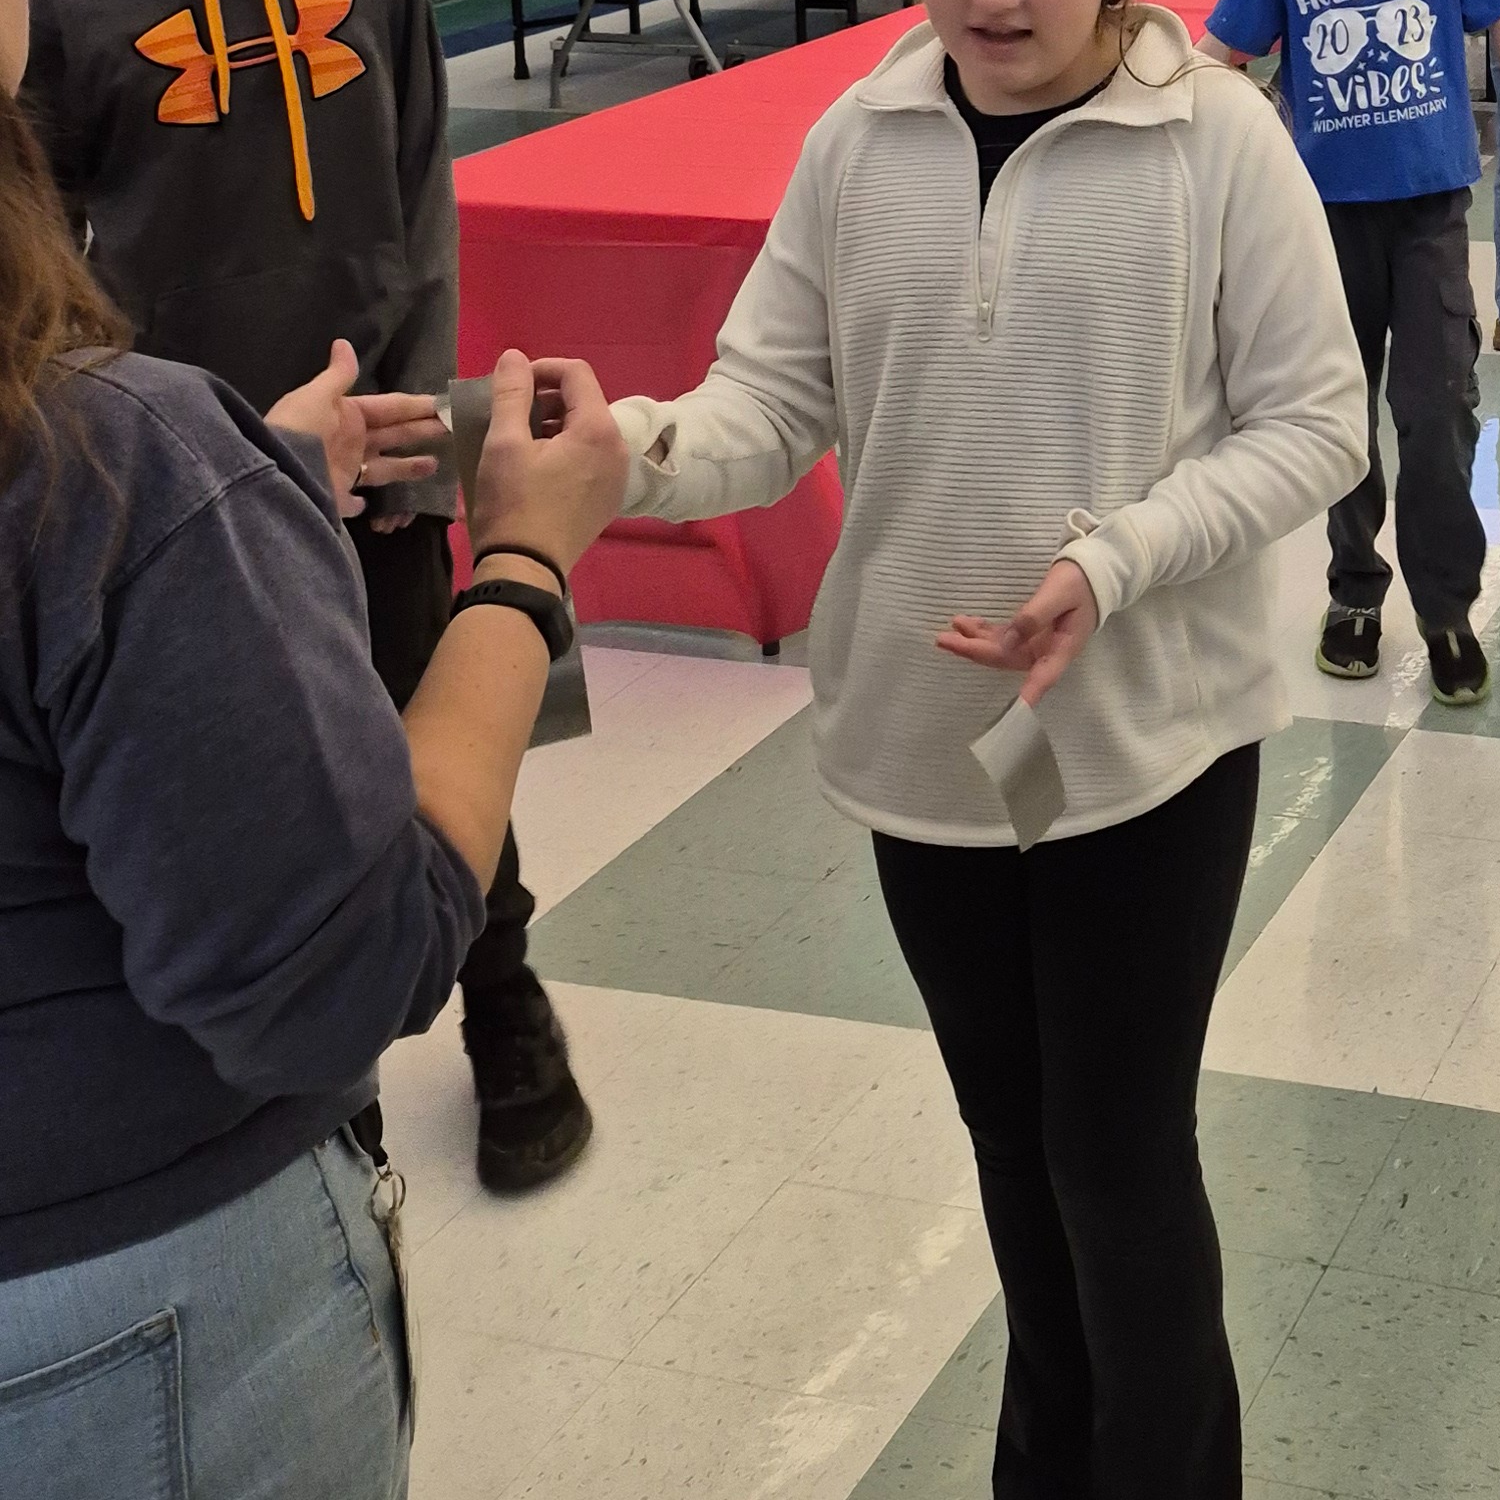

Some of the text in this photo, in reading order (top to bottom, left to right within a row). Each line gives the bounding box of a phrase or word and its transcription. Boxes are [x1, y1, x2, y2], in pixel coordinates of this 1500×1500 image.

[1316, 4, 1425, 60] 20 23
[1313, 96, 1448, 134] WIDMYER ELEMENTARY
